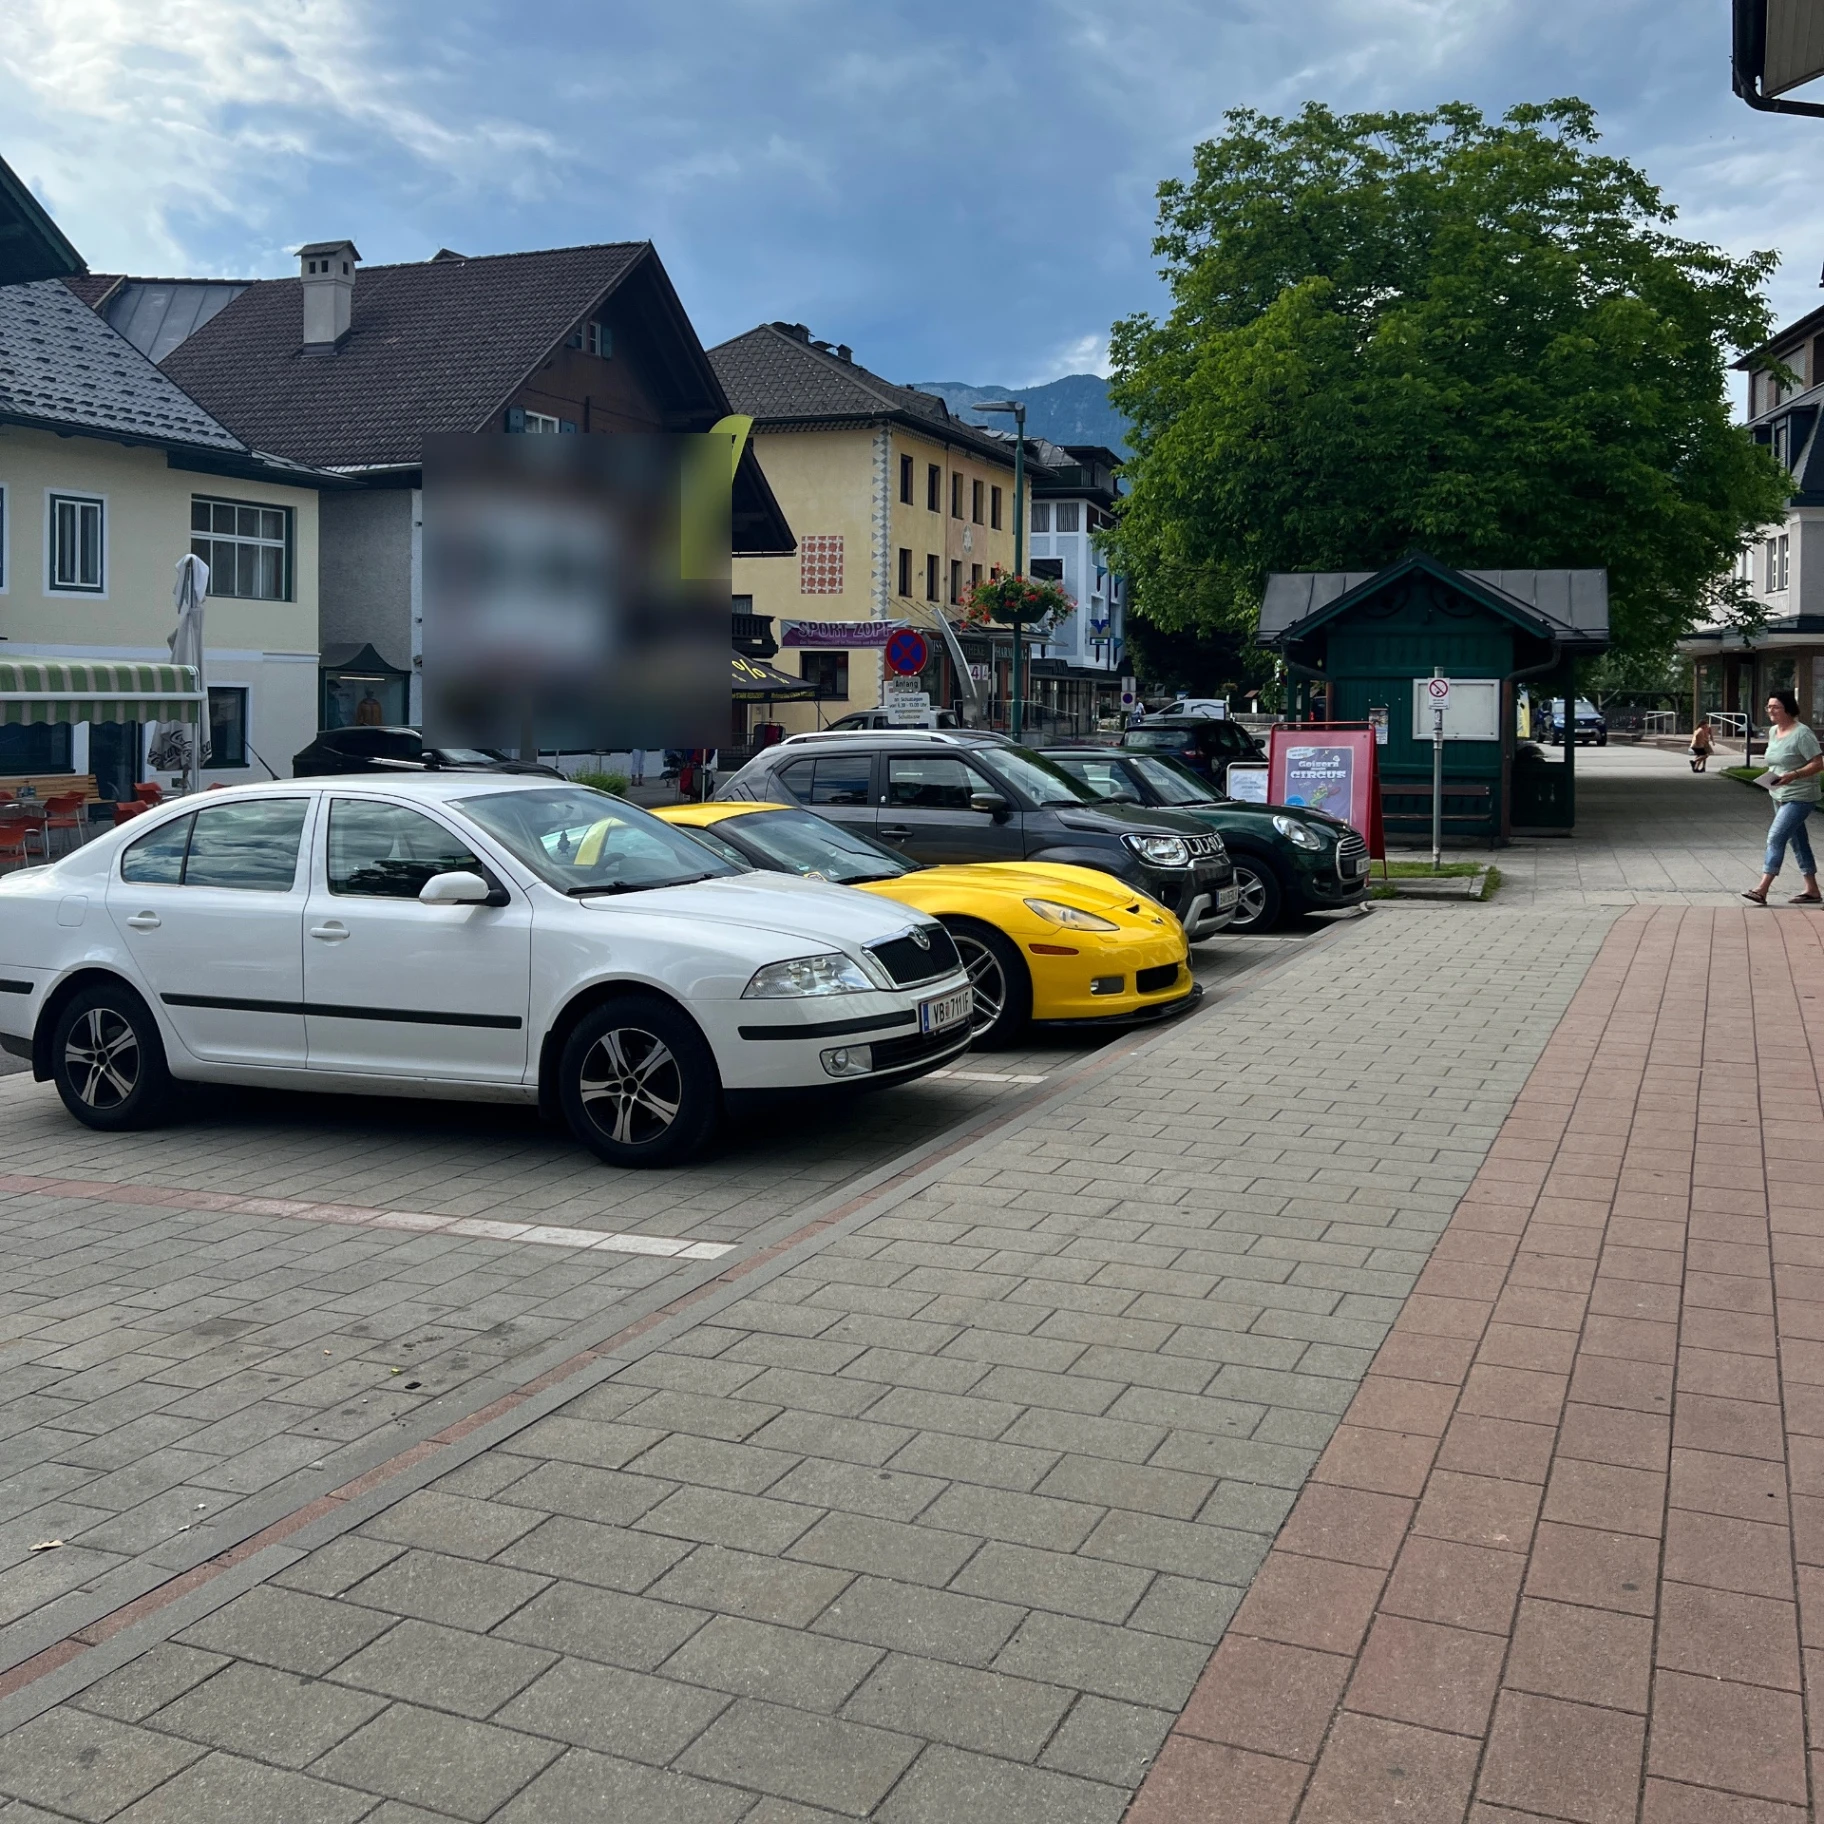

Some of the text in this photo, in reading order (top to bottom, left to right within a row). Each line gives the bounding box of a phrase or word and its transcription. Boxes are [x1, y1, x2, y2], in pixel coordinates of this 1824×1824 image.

[799, 620, 893, 638] SPORT ZOPF
[895, 680, 919, 689] Anfang
[1290, 770, 1347, 779] CIRCUS
[933, 1002, 945, 1025] VB
